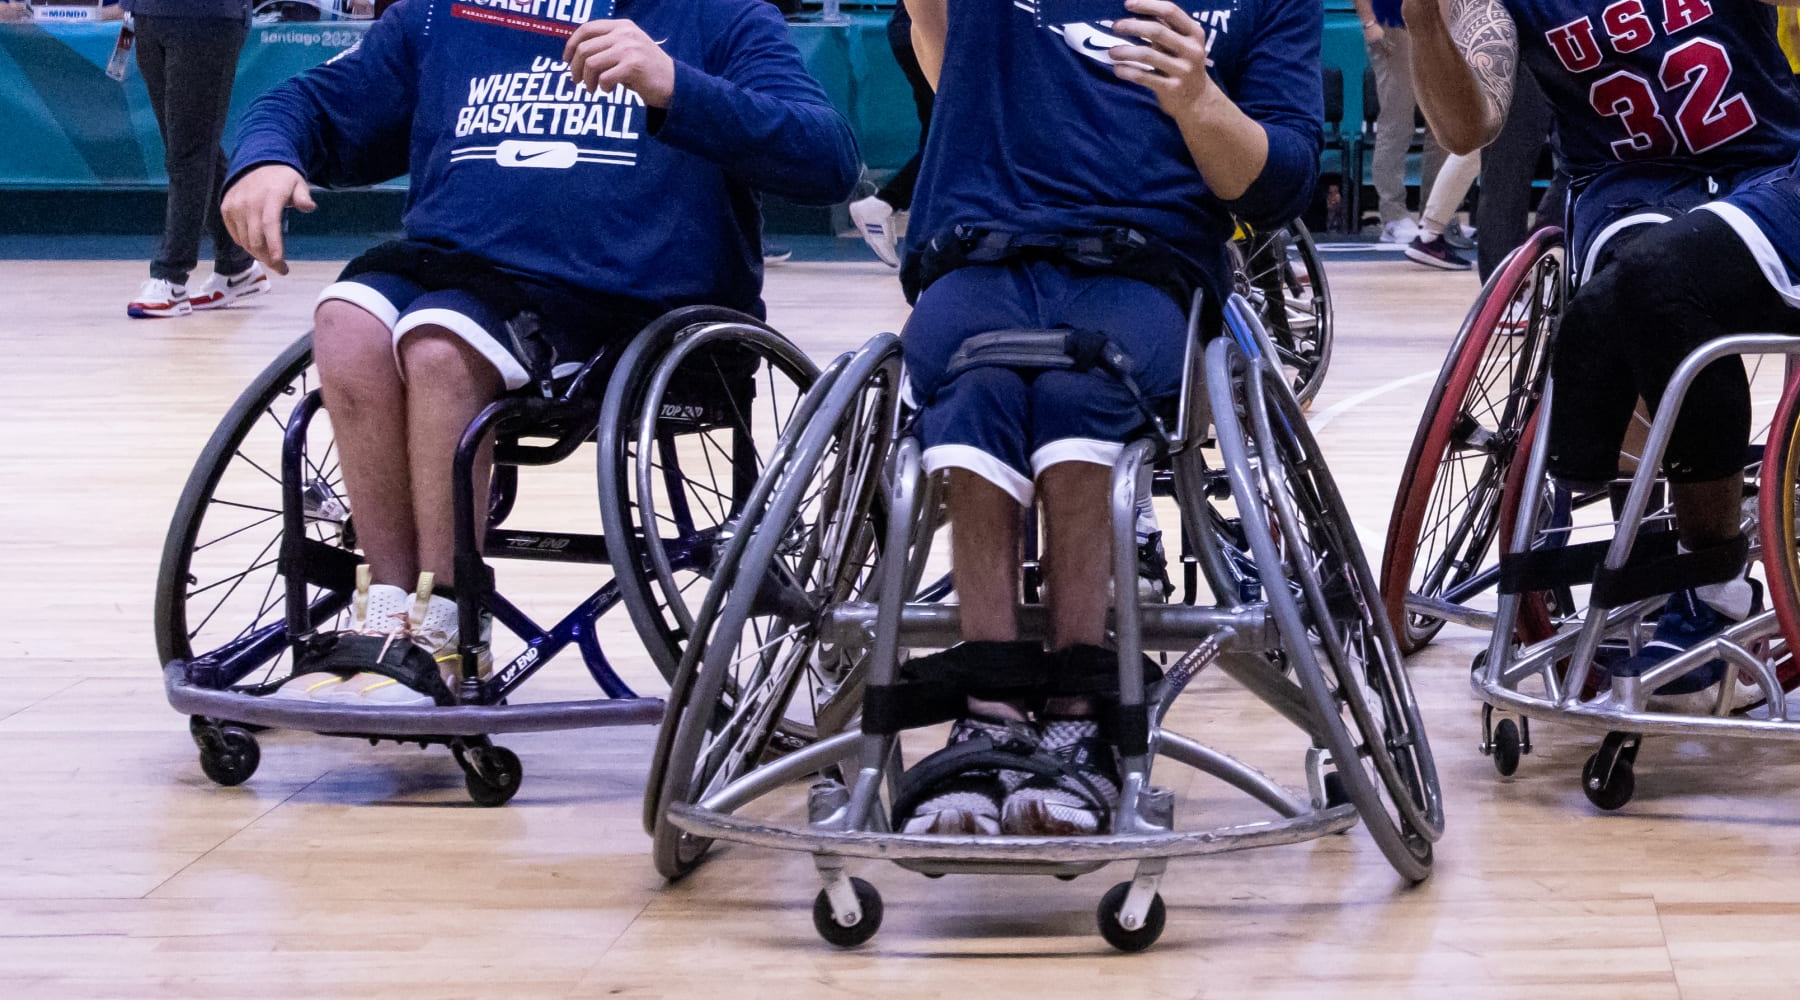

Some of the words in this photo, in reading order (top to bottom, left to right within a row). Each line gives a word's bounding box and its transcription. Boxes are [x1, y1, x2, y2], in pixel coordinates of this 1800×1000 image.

[48, 10, 87, 18] MONDO
[260, 30, 320, 46] Santiago
[1589, 37, 1758, 162] 32
[455, 102, 639, 139] BASKETBALL
[660, 404, 682, 417] TOP
[516, 647, 539, 671] END
